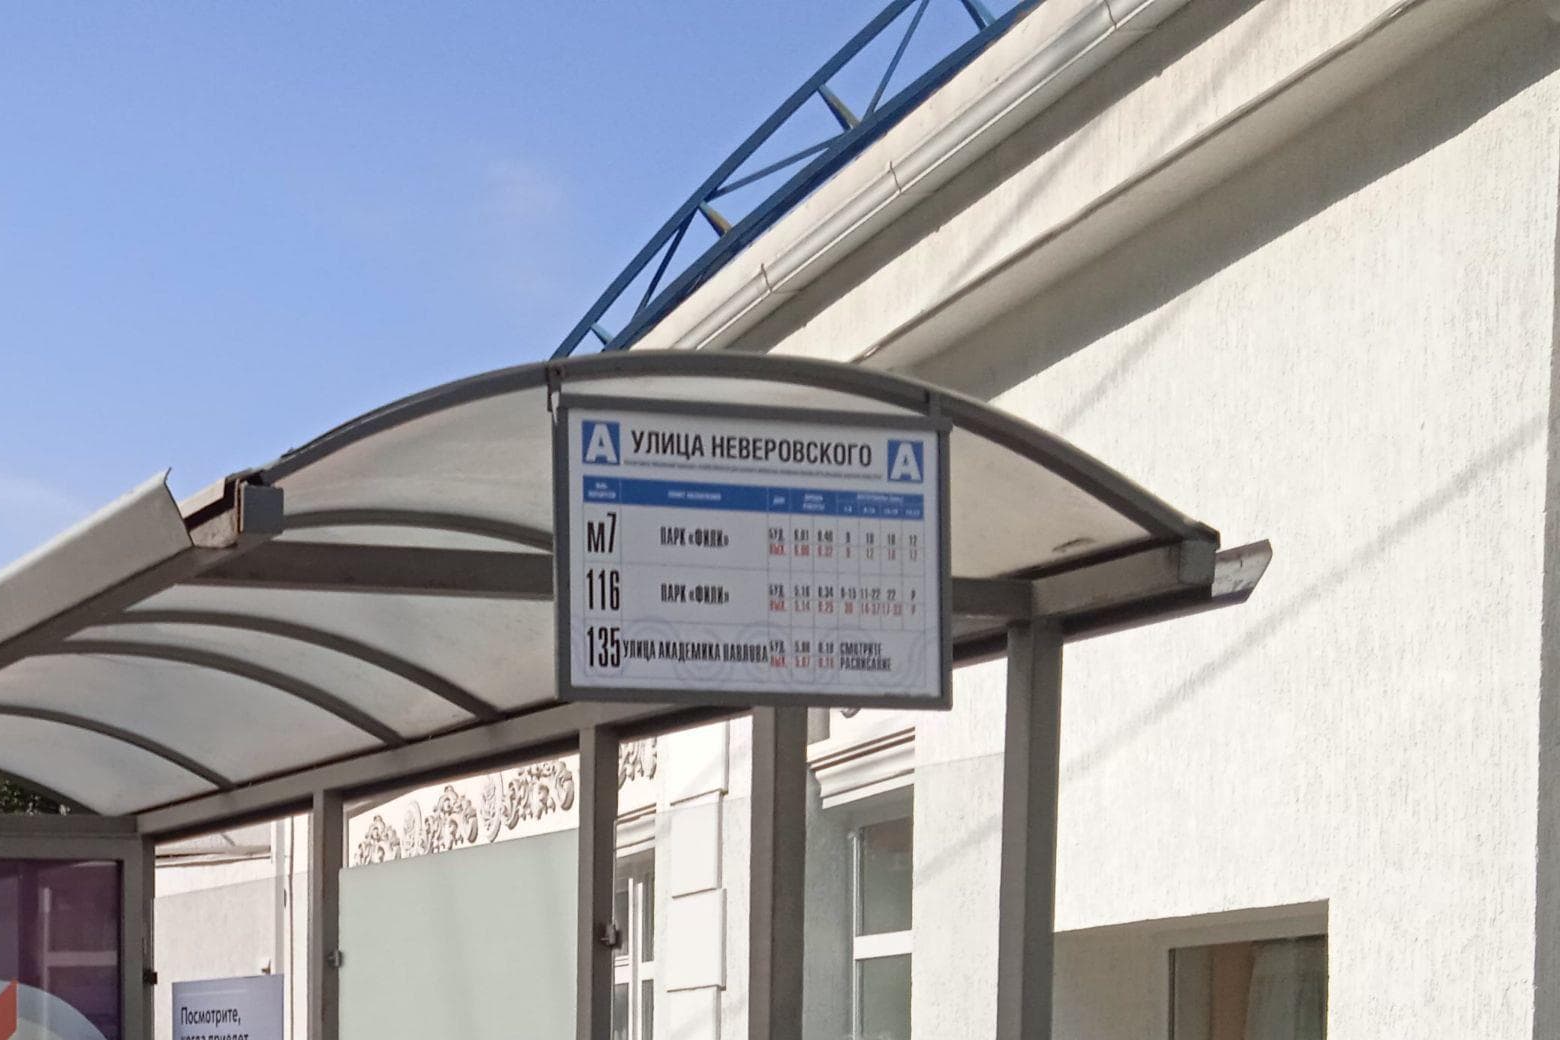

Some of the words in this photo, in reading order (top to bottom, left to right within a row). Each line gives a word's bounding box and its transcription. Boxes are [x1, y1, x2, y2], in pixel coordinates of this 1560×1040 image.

[631, 430, 705, 460] УЛИЦА
[712, 435, 873, 467] НЕВЕРОВСКОГО
[660, 526, 686, 546] ПАРК
[689, 528, 729, 548] «ФИЛИ»
[586, 569, 620, 611] 116
[661, 583, 686, 602] ПАРК
[689, 585, 729, 604] «ФИЛИ»
[587, 626, 620, 667] 135
[623, 640, 656, 661] УЛИЦА
[658, 641, 720, 662] АКАДЕМИКА
[724, 643, 769, 663] ПАВЛОВА
[840, 643, 882, 655] СМОТРИТЕ
[840, 657, 891, 672] РАСПИСАНИЕ
[181, 1007, 241, 1027] Посмотрите,
